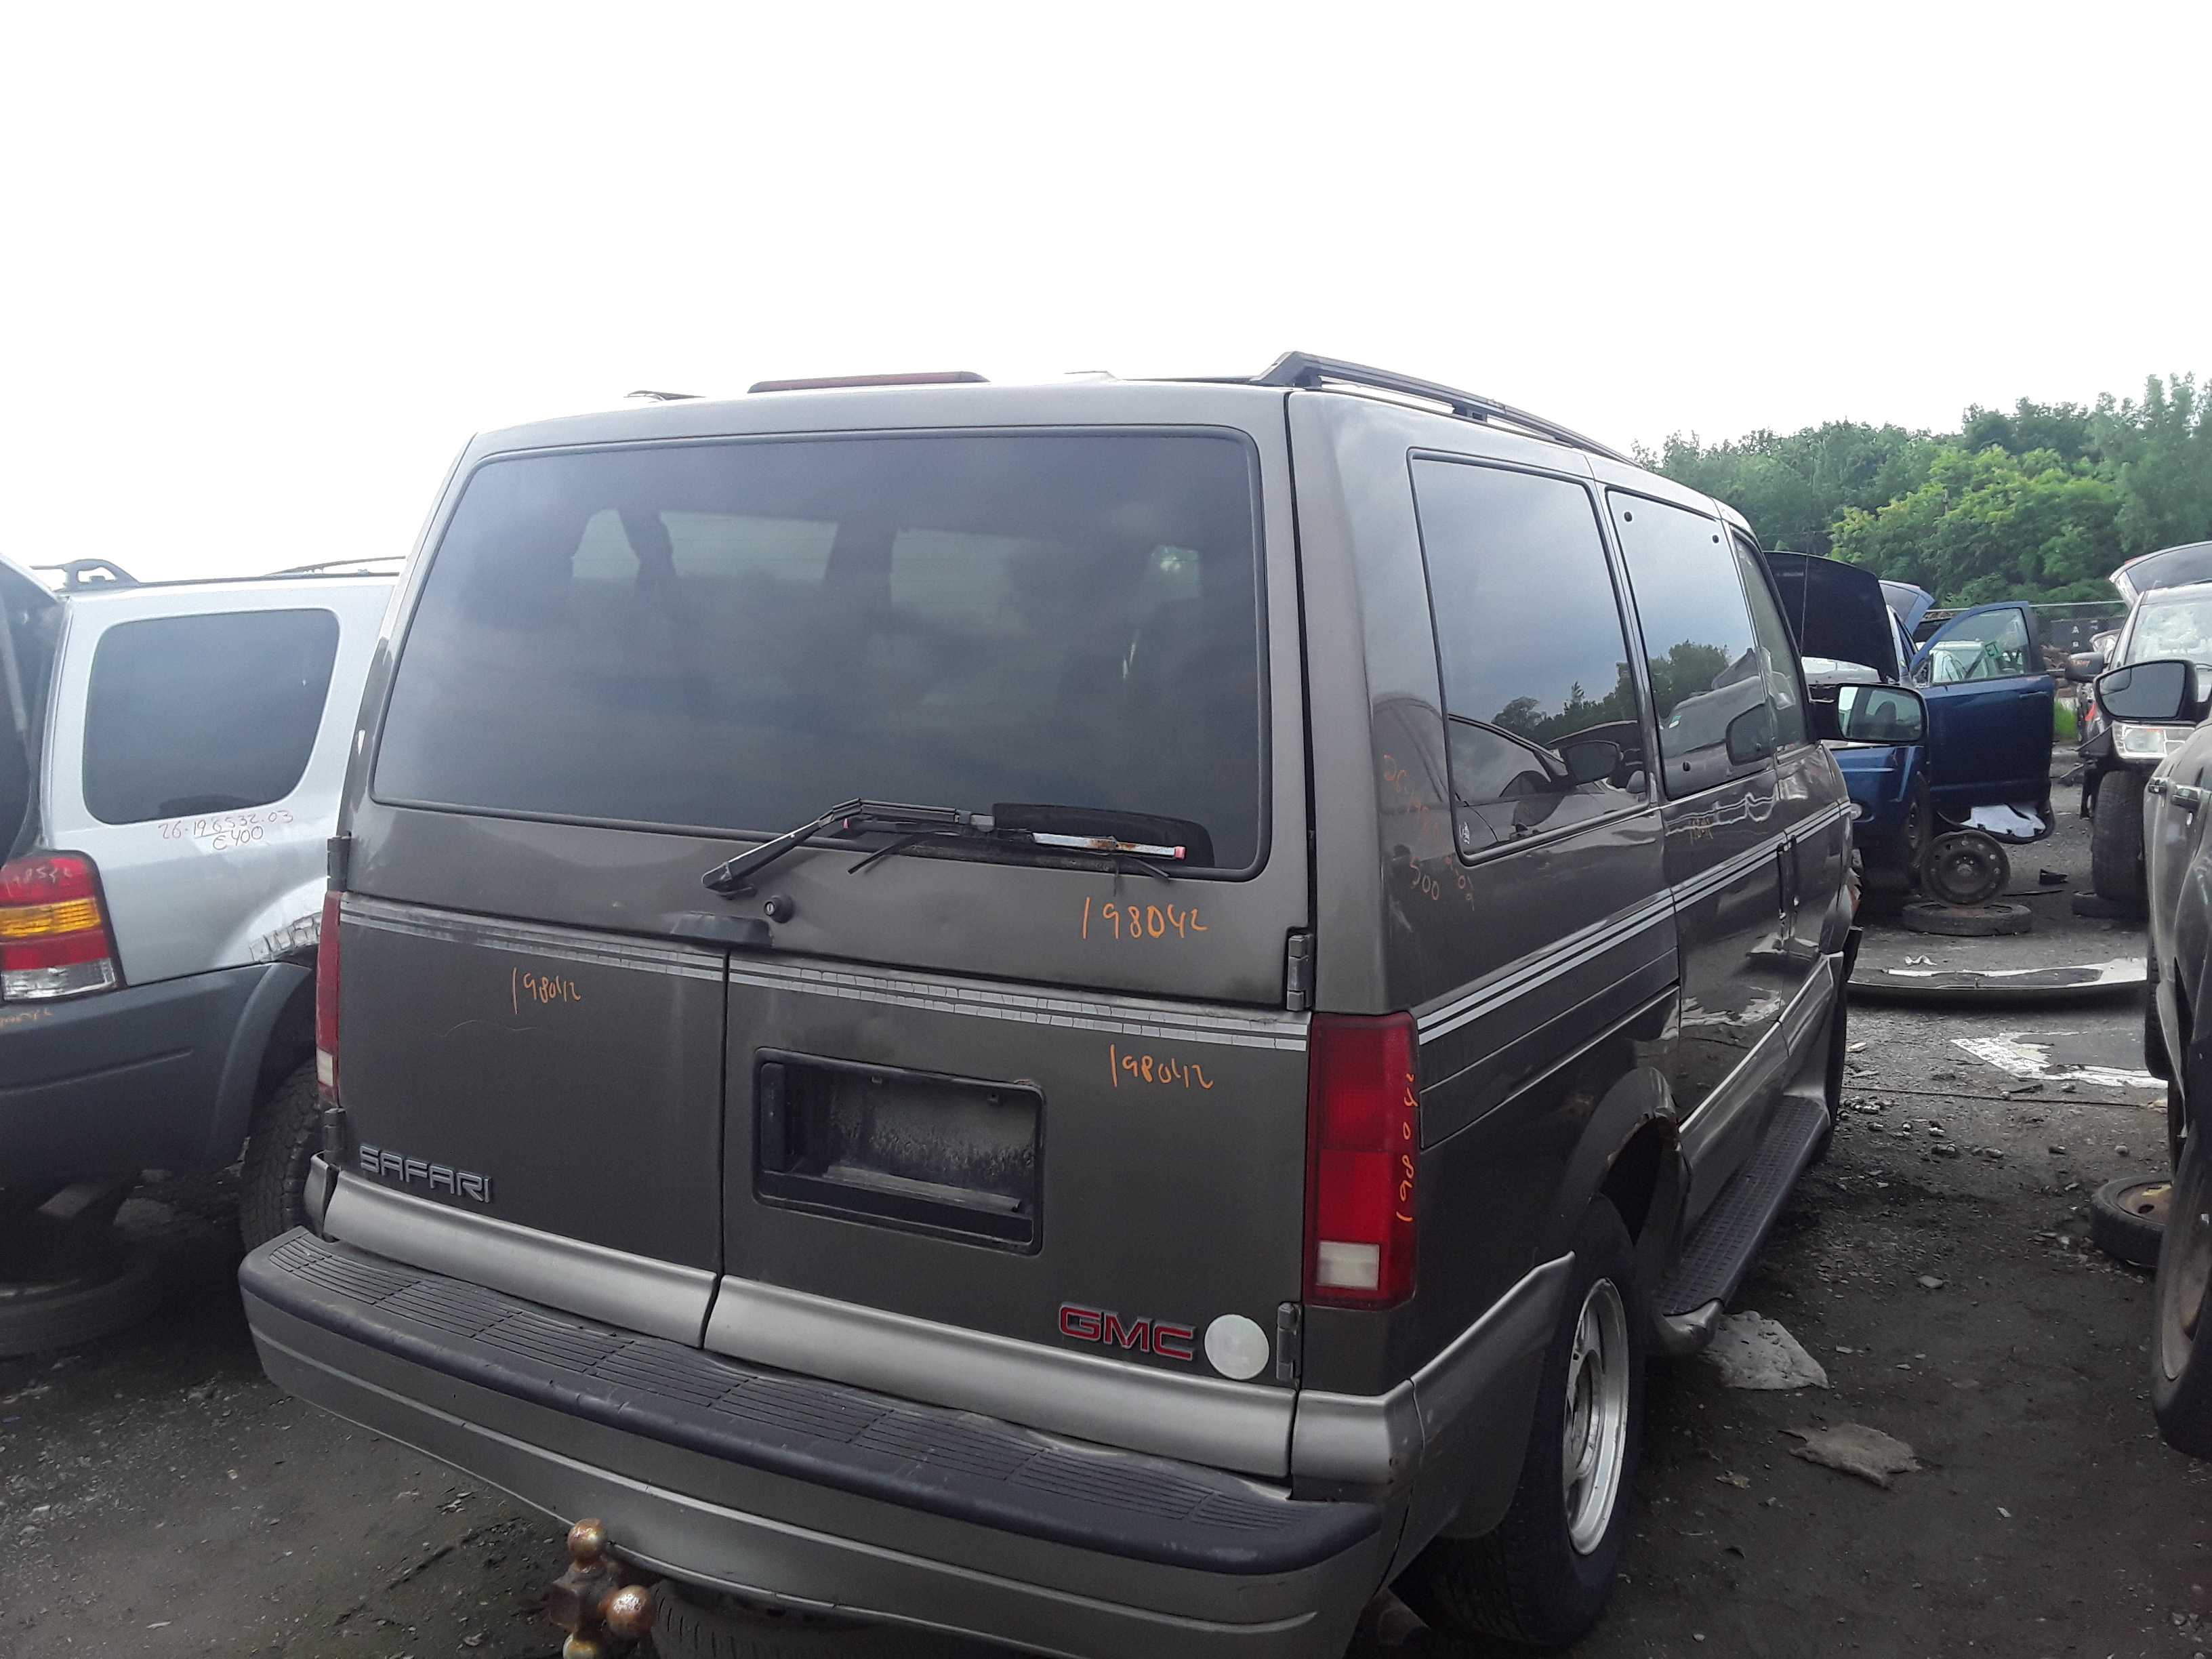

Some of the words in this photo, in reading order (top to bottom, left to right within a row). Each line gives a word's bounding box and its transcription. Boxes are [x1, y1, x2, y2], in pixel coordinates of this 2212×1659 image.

[1082, 897, 1208, 939] 198042
[359, 1144, 493, 1204] SAFARI
[1059, 1302, 1196, 1361] GMC
